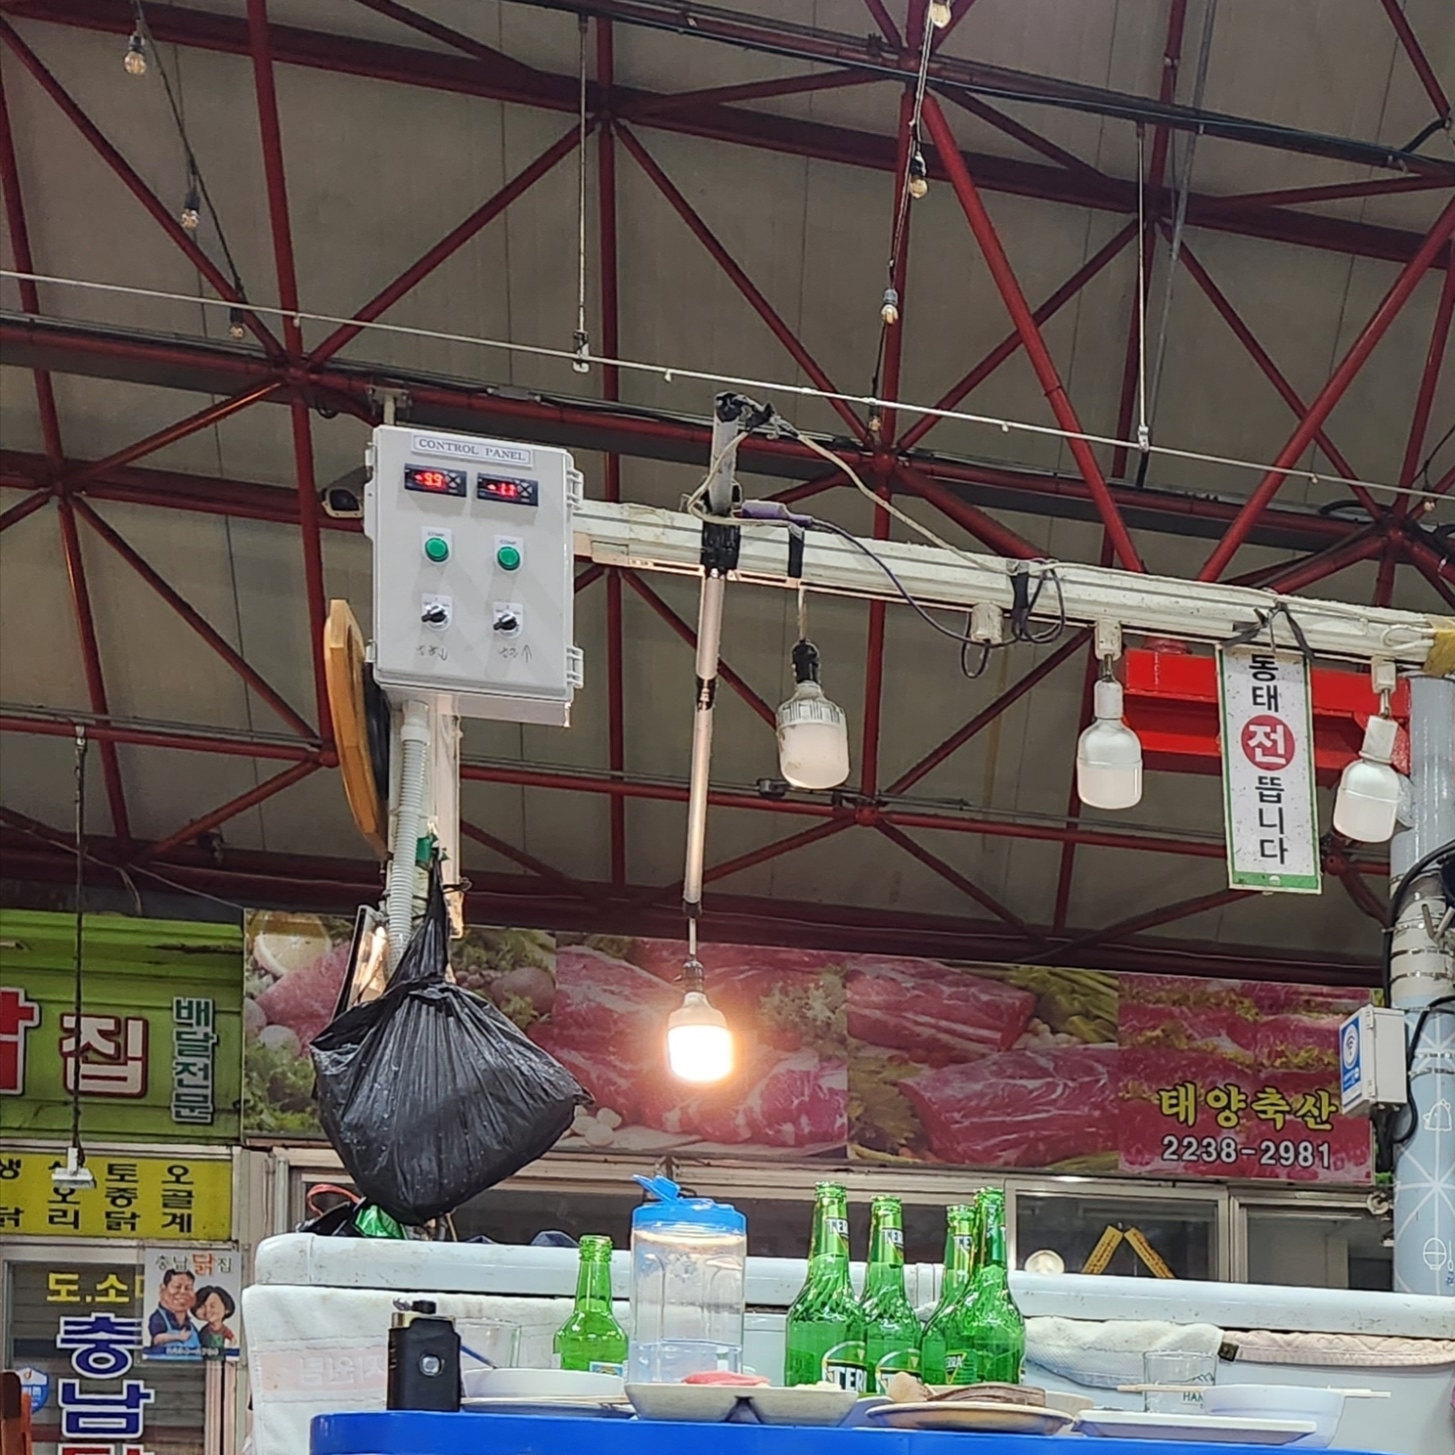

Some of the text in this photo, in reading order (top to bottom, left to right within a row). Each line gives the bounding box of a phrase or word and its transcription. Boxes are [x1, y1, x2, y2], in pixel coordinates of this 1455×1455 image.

[418, 438, 526, 461] CONTROL PANEL
[1254, 775, 1289, 866] 뜹니다
[171, 995, 217, 1124] 배달전문
[1156, 1081, 1340, 1131] 태양축산
[1160, 1134, 1331, 1169] 2238-2981
[104, 1162, 139, 1232] 토종닭
[160, 1163, 195, 1234] 오골계
[46, 1272, 145, 1303] 도.소
